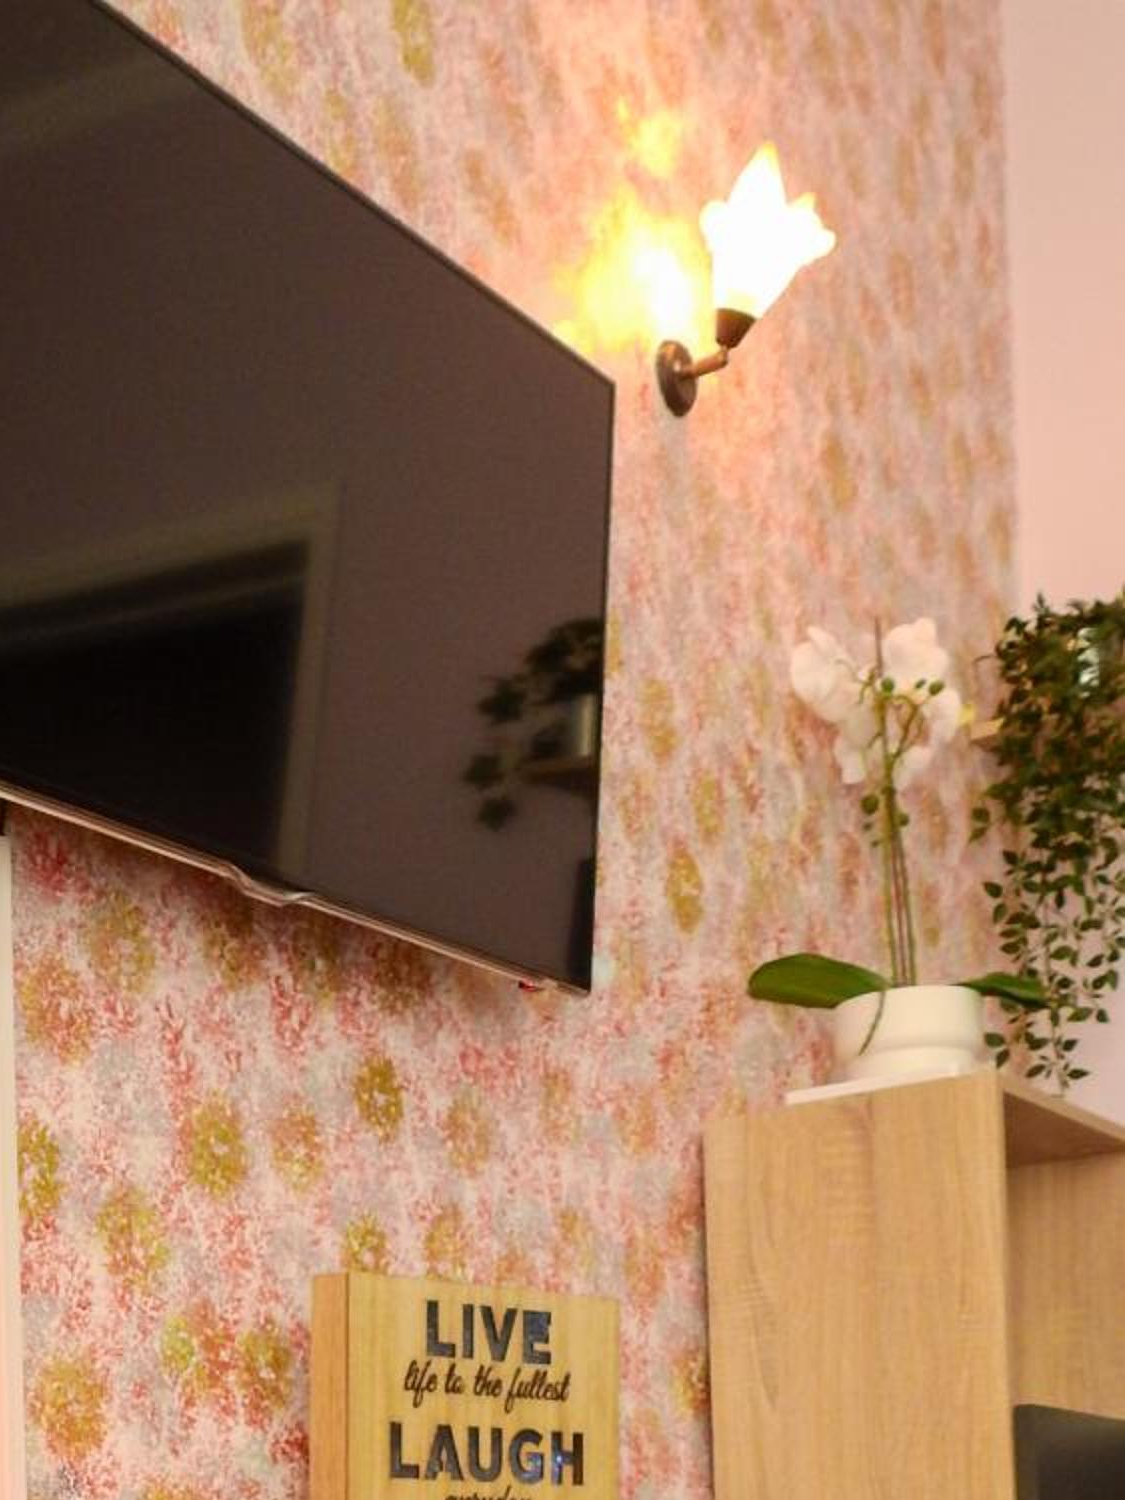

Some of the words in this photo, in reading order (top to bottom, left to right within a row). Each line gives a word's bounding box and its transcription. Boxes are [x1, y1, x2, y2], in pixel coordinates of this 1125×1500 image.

[426, 1300, 553, 1365] LIVE
[403, 1359, 437, 1408] life
[444, 1368, 465, 1393] to
[473, 1364, 504, 1400] the
[503, 1369, 572, 1413] fullest
[388, 1421, 585, 1486] LAUGH
